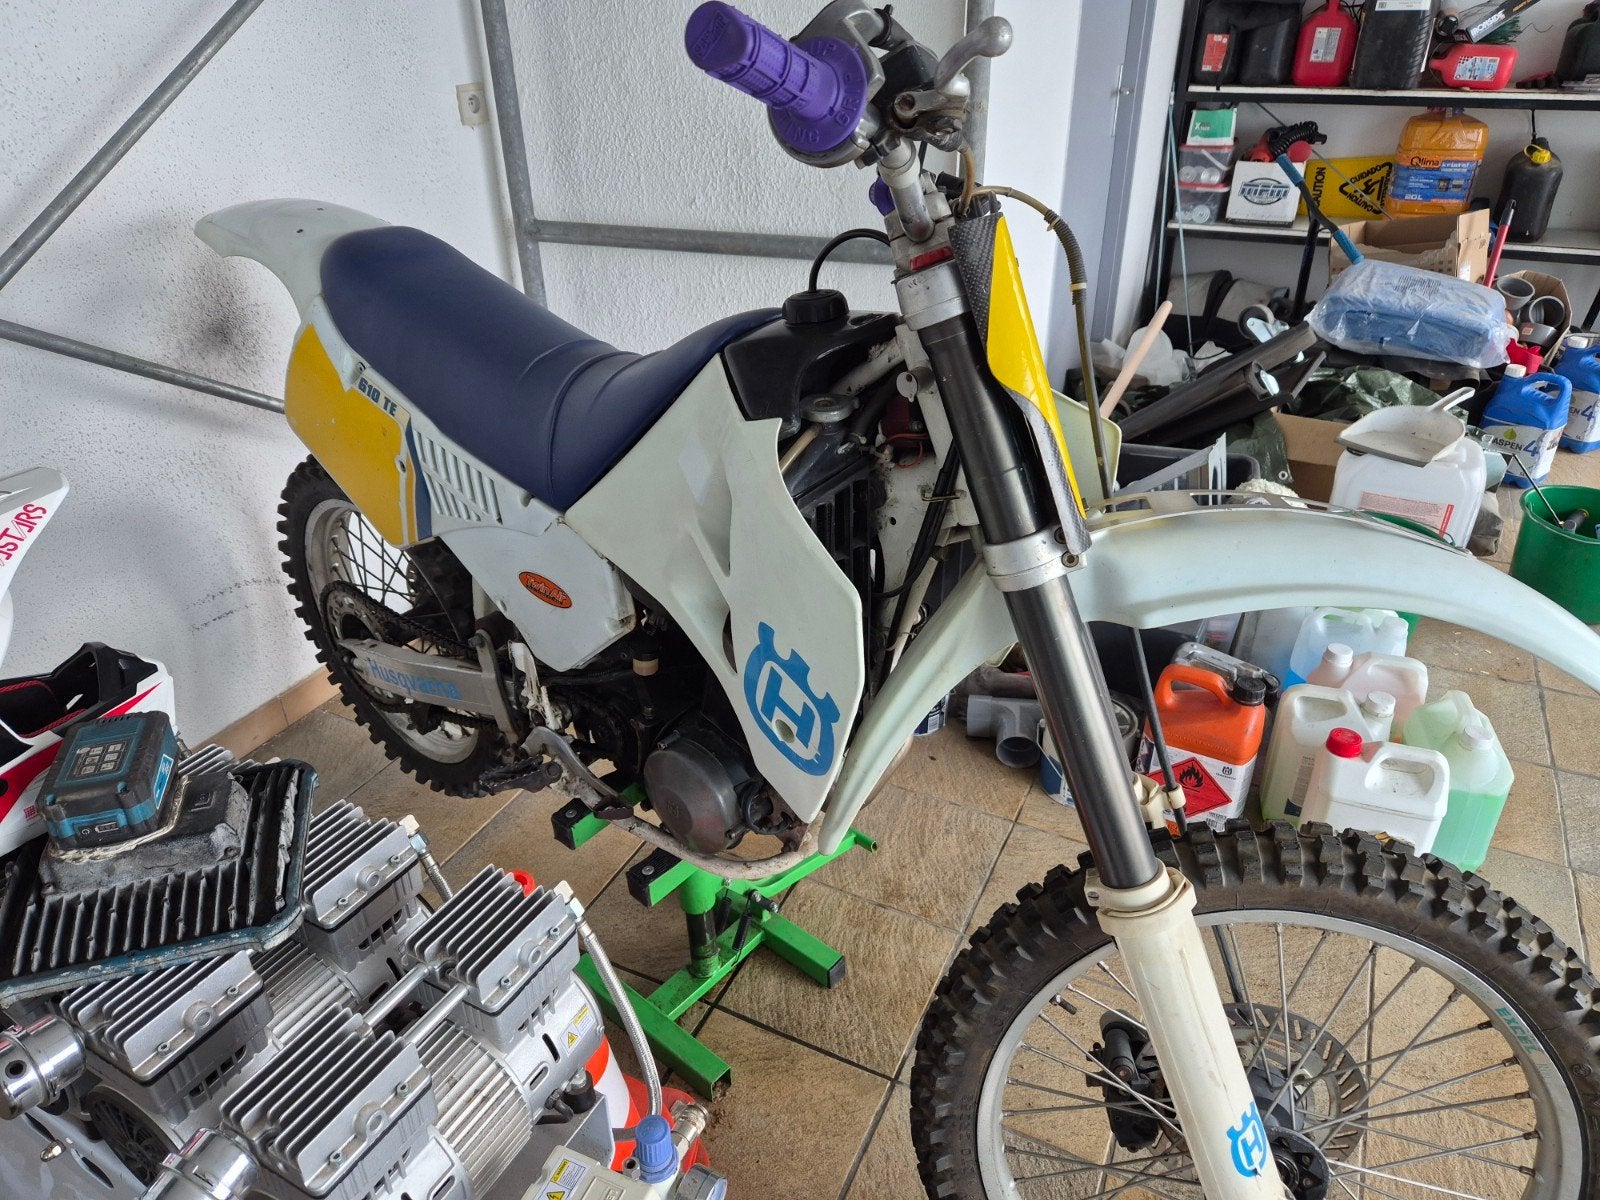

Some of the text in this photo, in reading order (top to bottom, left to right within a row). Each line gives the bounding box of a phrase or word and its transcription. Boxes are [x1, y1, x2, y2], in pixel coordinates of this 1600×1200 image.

[1411, 156, 1439, 167] Qlima
[1350, 164, 1382, 183] CUIDADO
[358, 377, 398, 417] 610 TE
[1492, 437, 1523, 451] ASPEN
[1523, 440, 1539, 457] 4
